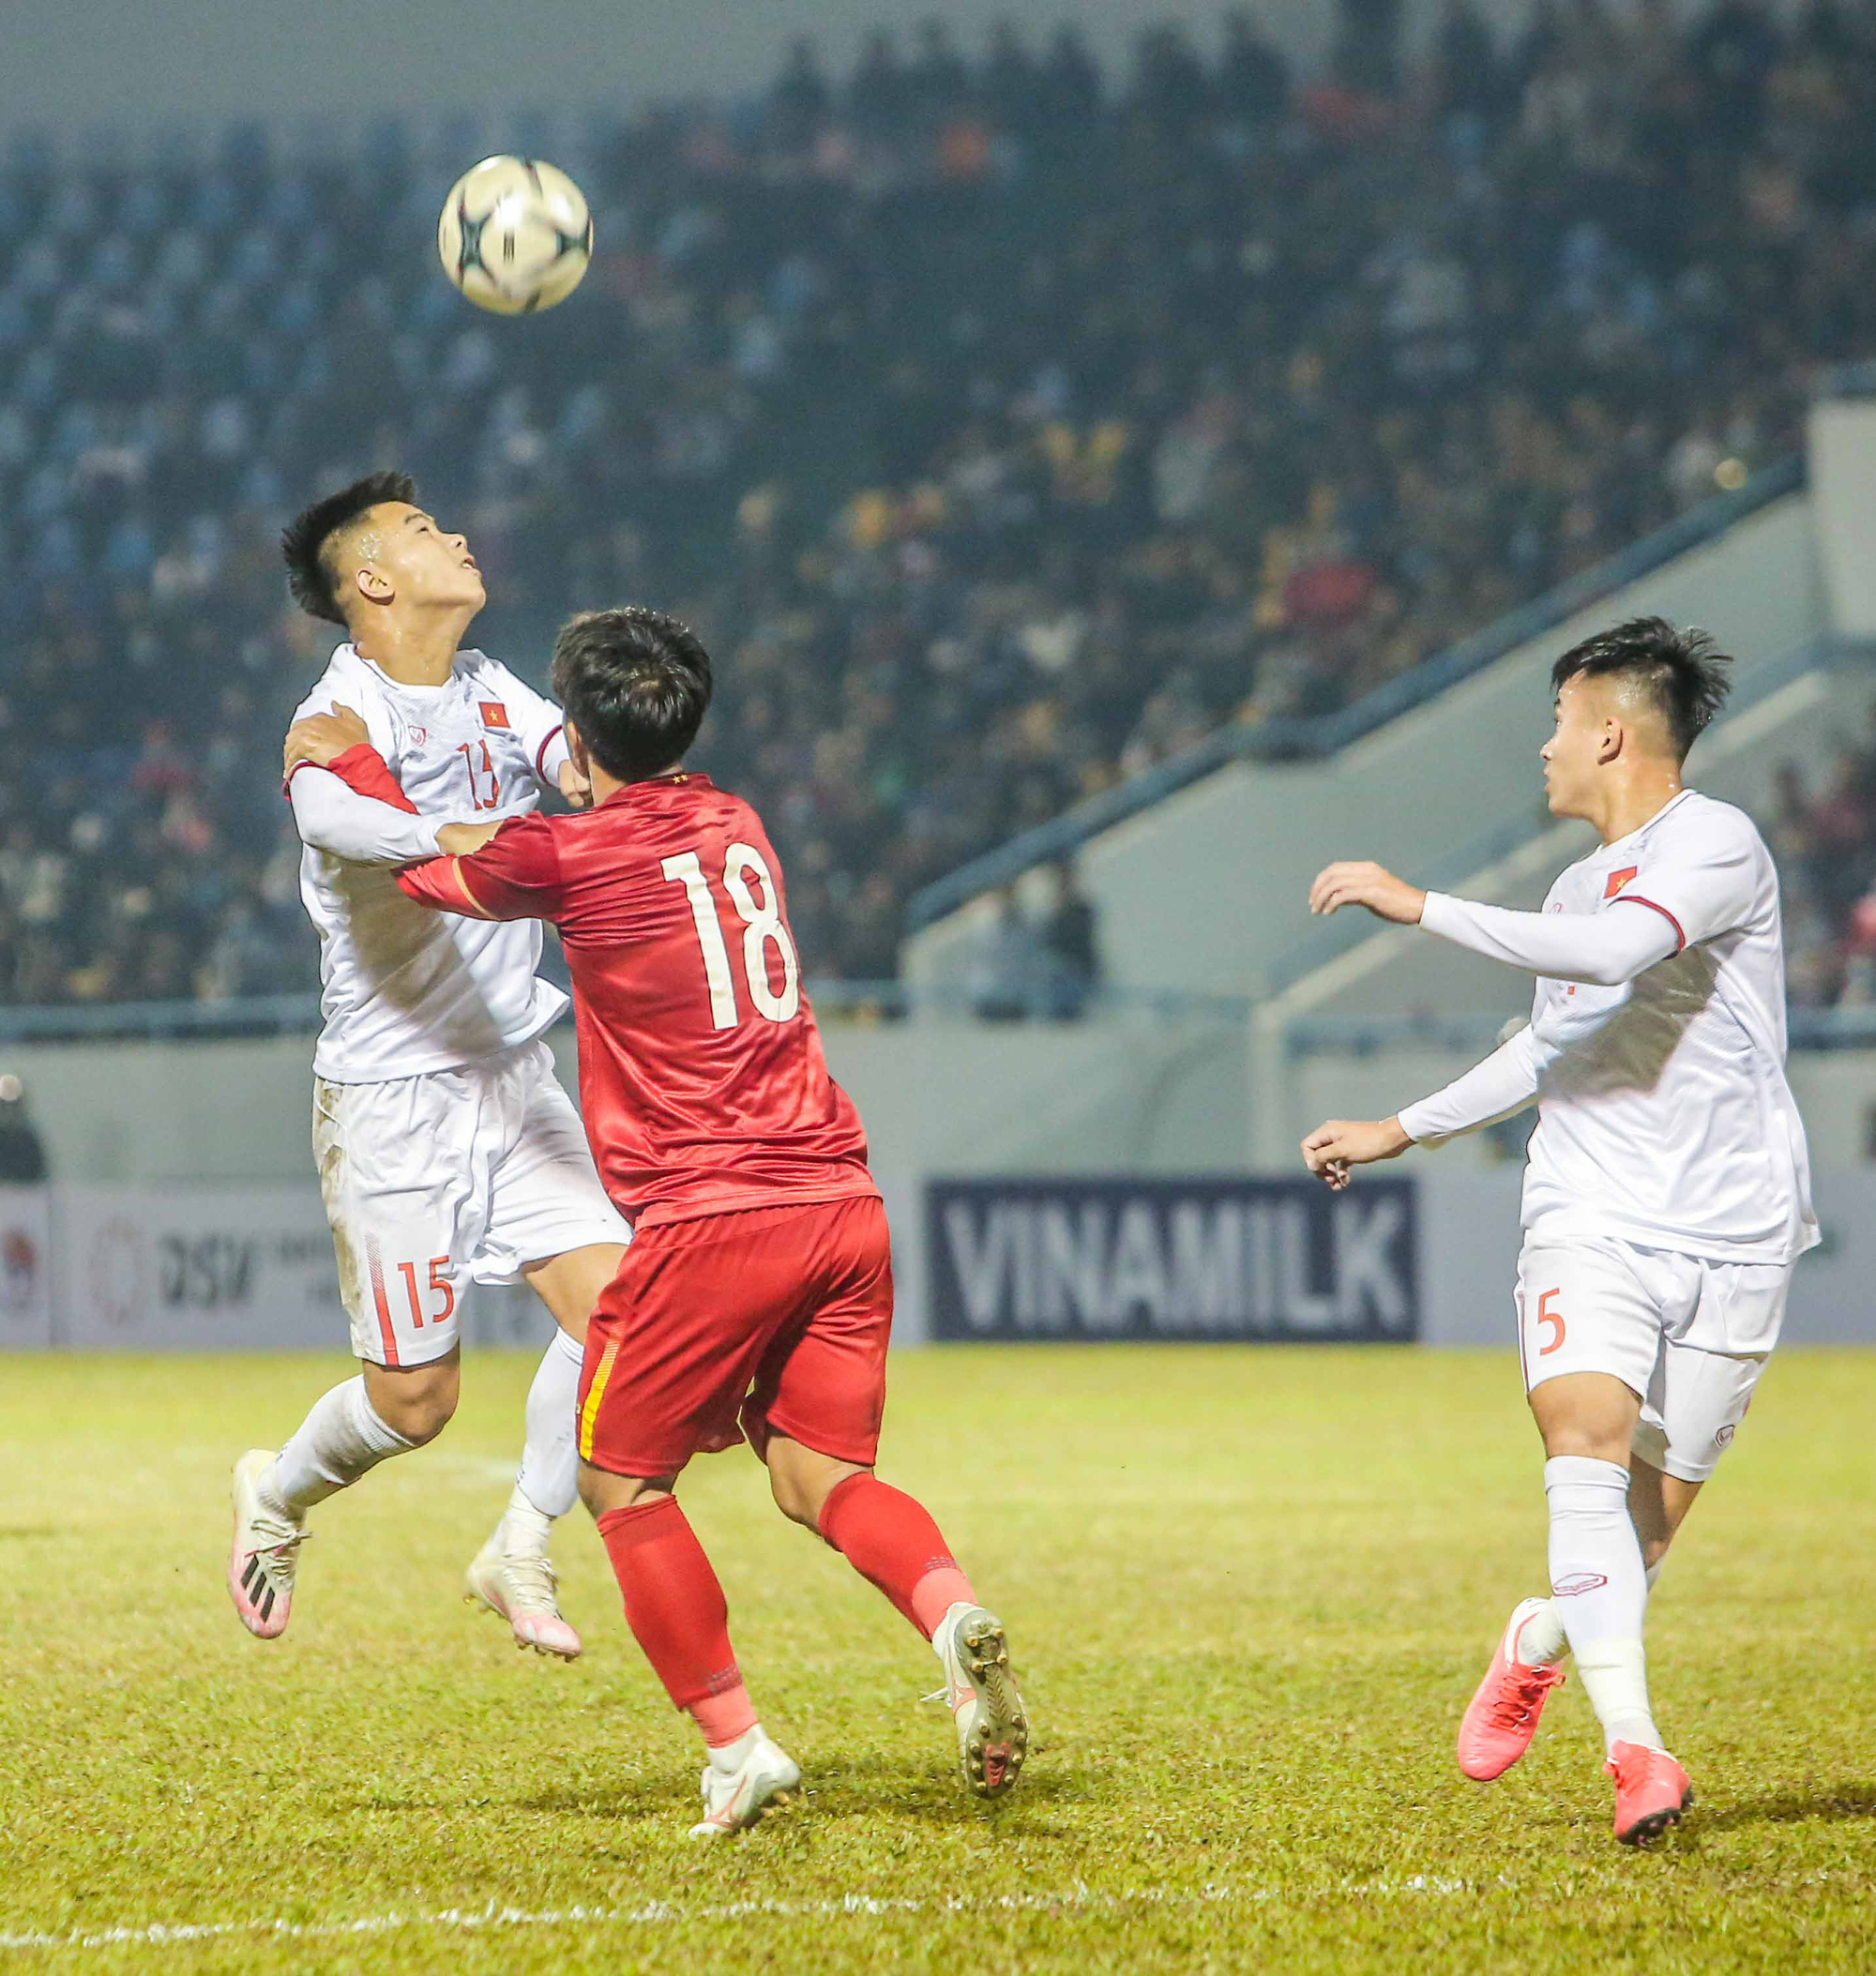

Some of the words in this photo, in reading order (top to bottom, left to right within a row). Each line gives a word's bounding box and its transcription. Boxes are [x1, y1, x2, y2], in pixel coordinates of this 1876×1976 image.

[659, 840, 799, 1031] 18
[398, 1255, 455, 1328] 15
[944, 1196, 1409, 1331] VINAMILK
[1537, 1288, 1566, 1356] 5
